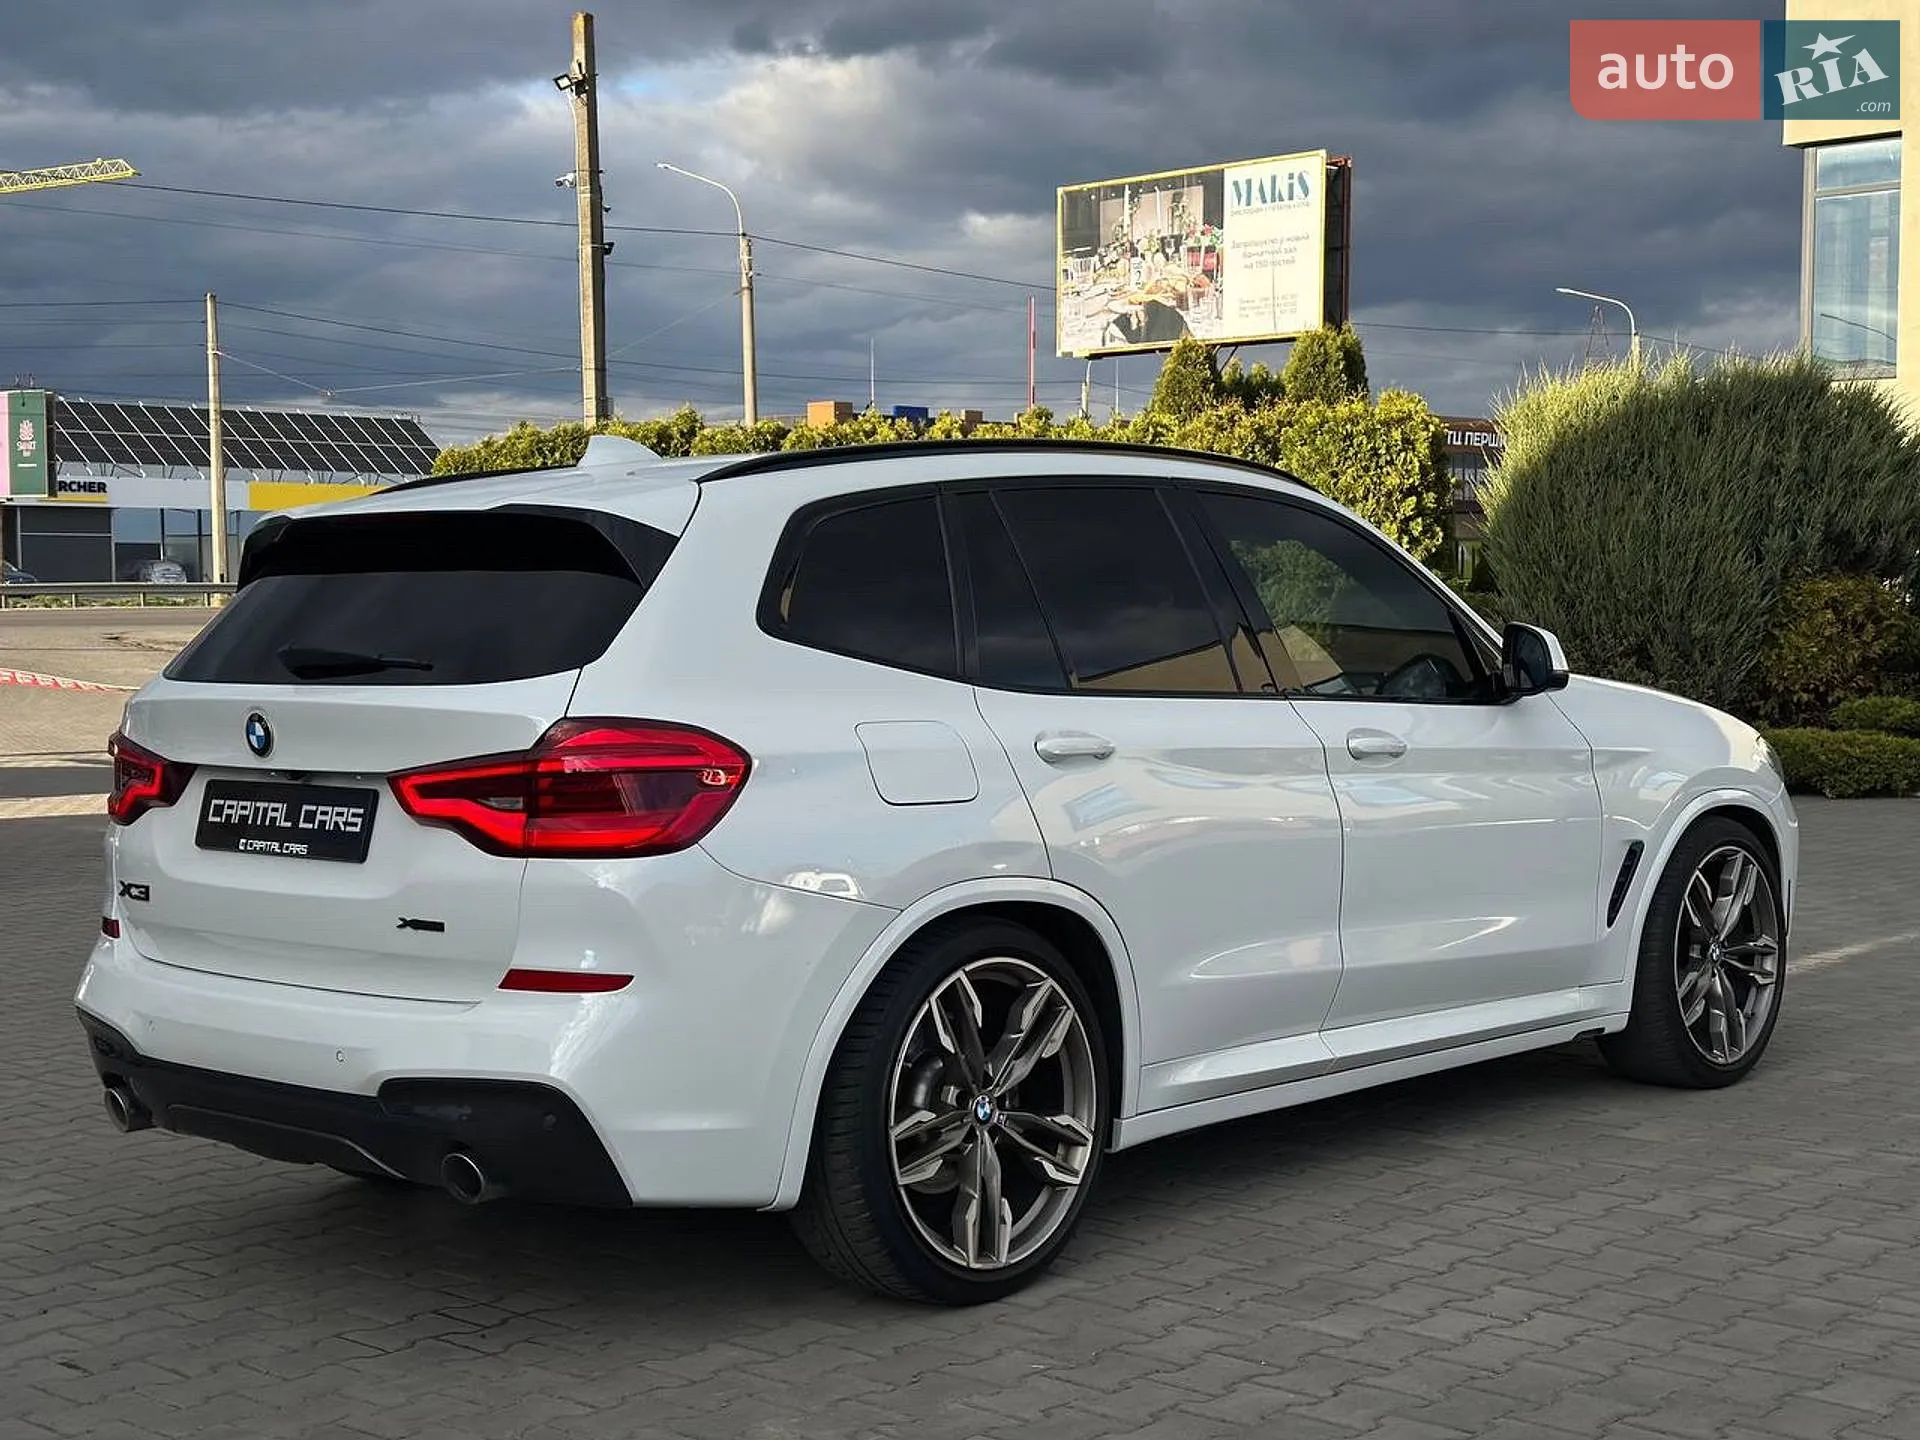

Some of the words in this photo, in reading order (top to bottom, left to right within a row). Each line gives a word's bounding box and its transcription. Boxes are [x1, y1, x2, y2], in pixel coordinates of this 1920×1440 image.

[208, 799, 292, 828] CAPITAL
[298, 804, 365, 833] CARS
[282, 842, 308, 855] CARS
